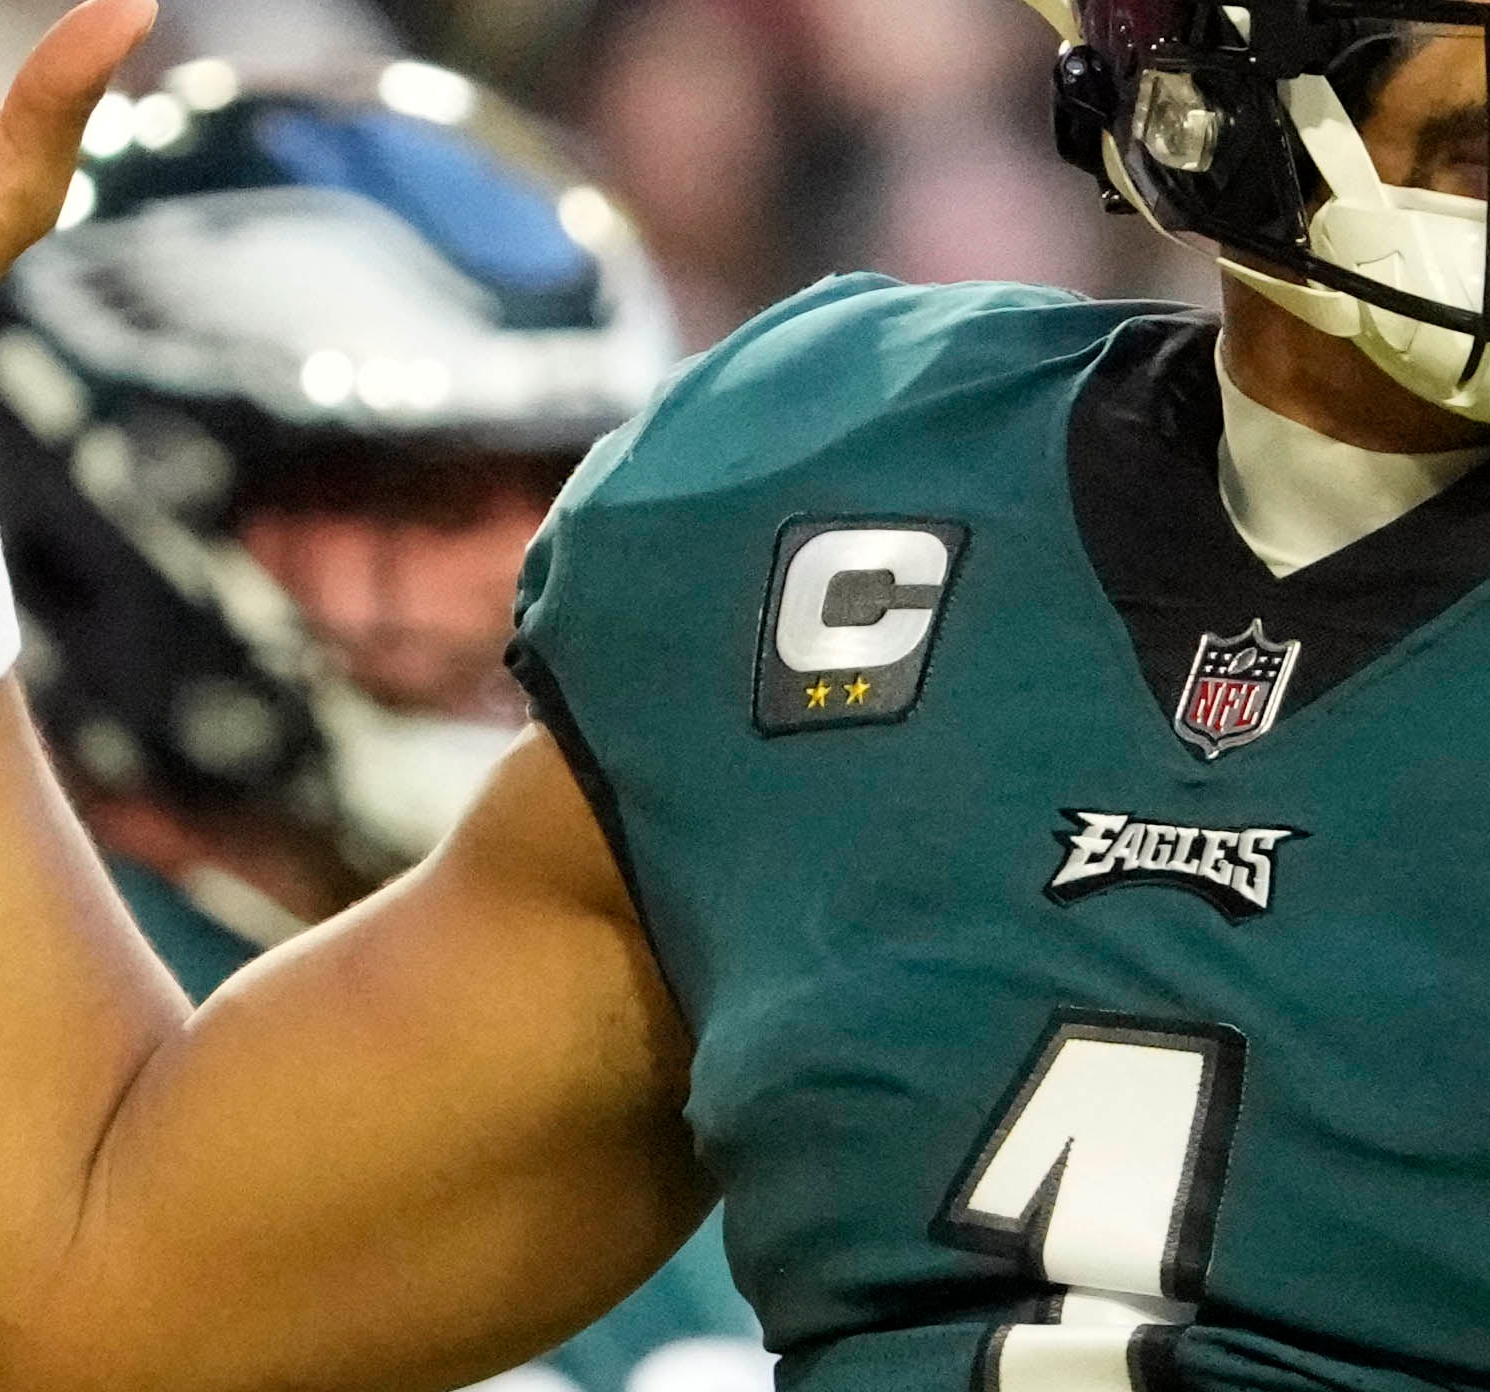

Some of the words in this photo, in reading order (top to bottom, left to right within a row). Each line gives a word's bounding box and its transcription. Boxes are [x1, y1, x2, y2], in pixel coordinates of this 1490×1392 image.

[774, 528, 950, 673] C
[1191, 679, 1262, 733] NFL
[1051, 811, 1294, 909] EAGLES
